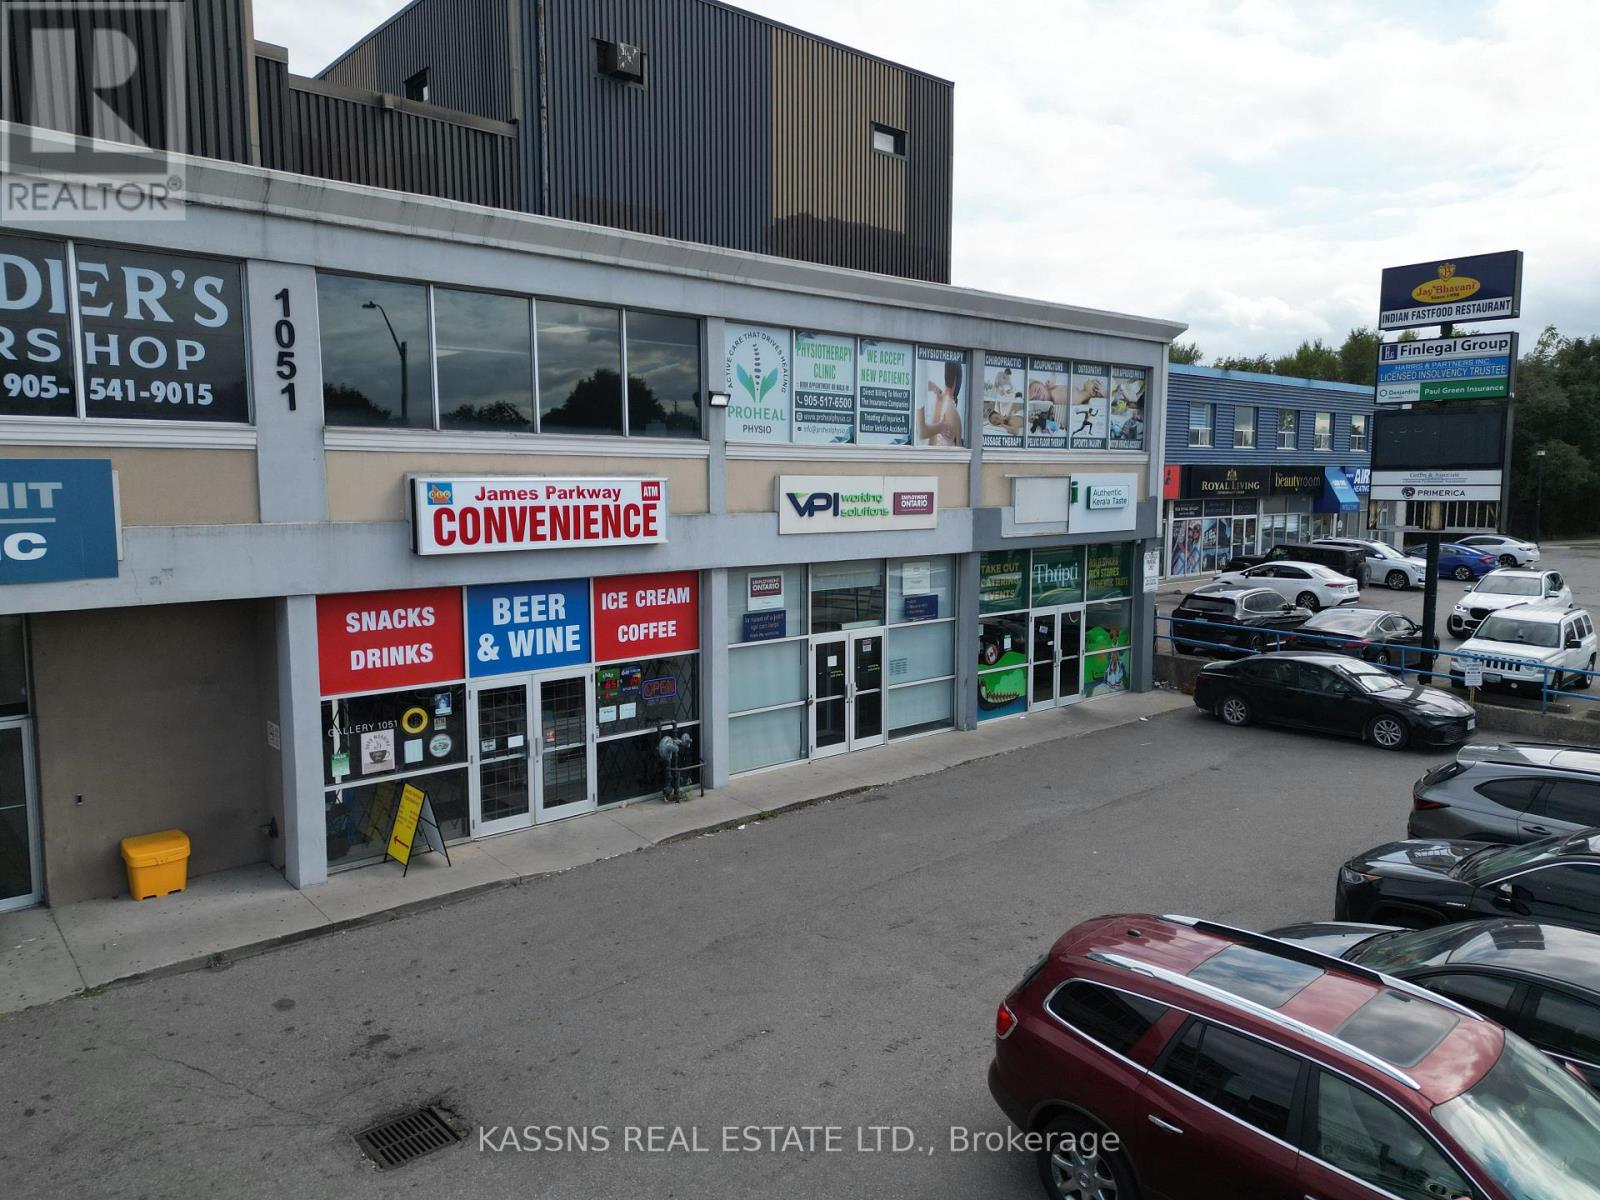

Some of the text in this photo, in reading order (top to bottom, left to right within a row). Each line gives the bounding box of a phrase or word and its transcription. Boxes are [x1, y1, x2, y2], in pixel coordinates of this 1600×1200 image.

[1382, 300, 1511, 323] INDIAN FASTFOOD RESTAURANT
[275, 287, 296, 411] 1051
[729, 336, 743, 356] CARE
[743, 331, 760, 340] THAT
[796, 342, 852, 361] PHYSIOTHERAPY
[1400, 341, 1457, 357] Finlegal
[1461, 339, 1509, 352] Group
[867, 349, 904, 366] WE ACCEPT
[919, 347, 964, 361] PHYSIOTHERAPY
[985, 355, 1022, 368] CHIROPRACTIC
[813, 363, 836, 379] CLINIC
[1431, 360, 1473, 369] PARTNERS
[861, 368, 910, 385] NEW PATIENTS
[1380, 365, 1506, 382] LICENSED INSOLVENCY TRUSTEE
[1424, 387, 1440, 395] Paul
[1441, 386, 1465, 394] Green
[1467, 385, 1504, 393] Insurance
[804, 395, 852, 408] 905-517-6500
[728, 405, 786, 421] PROHEAL
[743, 424, 772, 434] PHYSIO
[983, 436, 1001, 446] ASSAGE
[475, 485, 622, 502] James Parkway
[643, 486, 659, 497] ATM
[1093, 488, 1122, 496] Authentic
[1202, 480, 1260, 491] ROYAL LIVING
[1418, 489, 1466, 497] PRIMERICA
[786, 492, 840, 517] VPI
[901, 499, 928, 507] ONTARIO
[1092, 497, 1127, 506] Kerala Taste
[840, 506, 890, 517] solutions
[433, 503, 658, 546] CONVENIENCE
[980, 563, 1020, 574] TAKE OUT
[752, 582, 780, 591] ONTARIO
[601, 587, 690, 610] ICE CREAM
[492, 593, 566, 626] BEER
[345, 606, 435, 633] SNACKS
[618, 621, 676, 643] COFFEE
[476, 625, 580, 663] & WINE
[350, 643, 434, 671] DRINKS
[644, 678, 675, 698] OPEN
[378, 720, 398, 730] 1051
